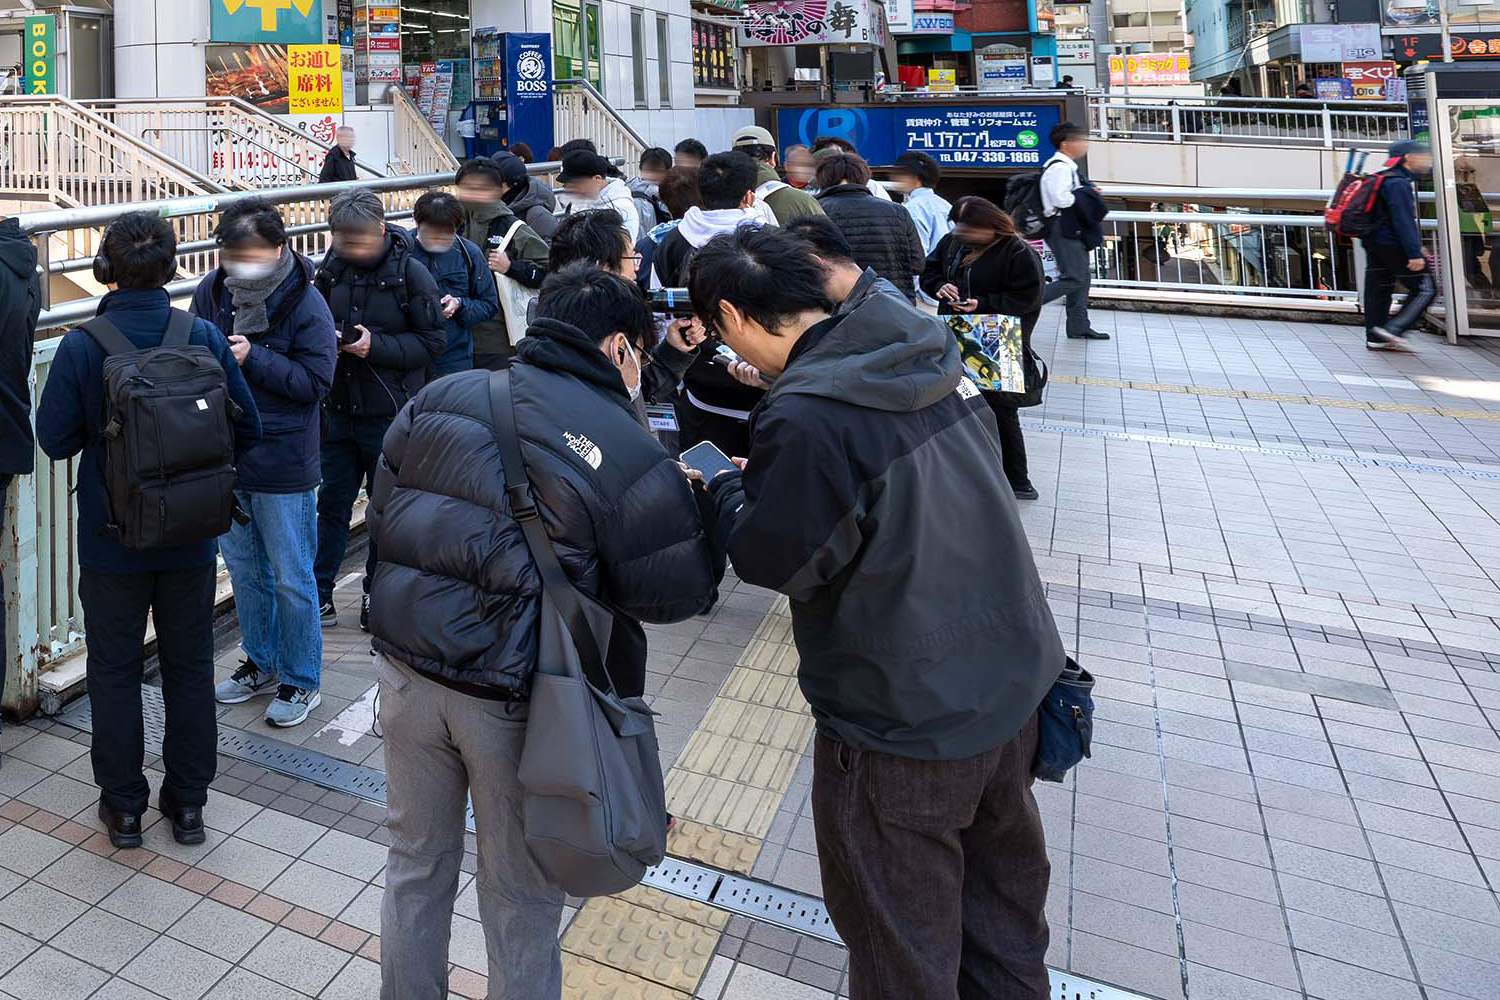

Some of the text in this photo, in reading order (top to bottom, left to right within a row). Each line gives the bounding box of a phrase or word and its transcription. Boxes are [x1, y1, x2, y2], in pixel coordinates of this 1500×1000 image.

[914, 18, 953, 29] AWSO
[1401, 37, 1419, 47] 1F
[519, 50, 543, 60] COFFEE
[1077, 52, 1090, 60] 3F
[1347, 48, 1376, 57] BIG
[291, 50, 339, 69] お通し
[1345, 67, 1394, 80] 宝くじ
[297, 74, 333, 92] 席料
[516, 80, 547, 92] BOSS
[291, 97, 340, 108] ございません!
[953, 152, 1040, 163] 047-330-1866
[563, 431, 593, 453] NORTH
[579, 433, 596, 448] THE
[566, 441, 587, 459] FACE
